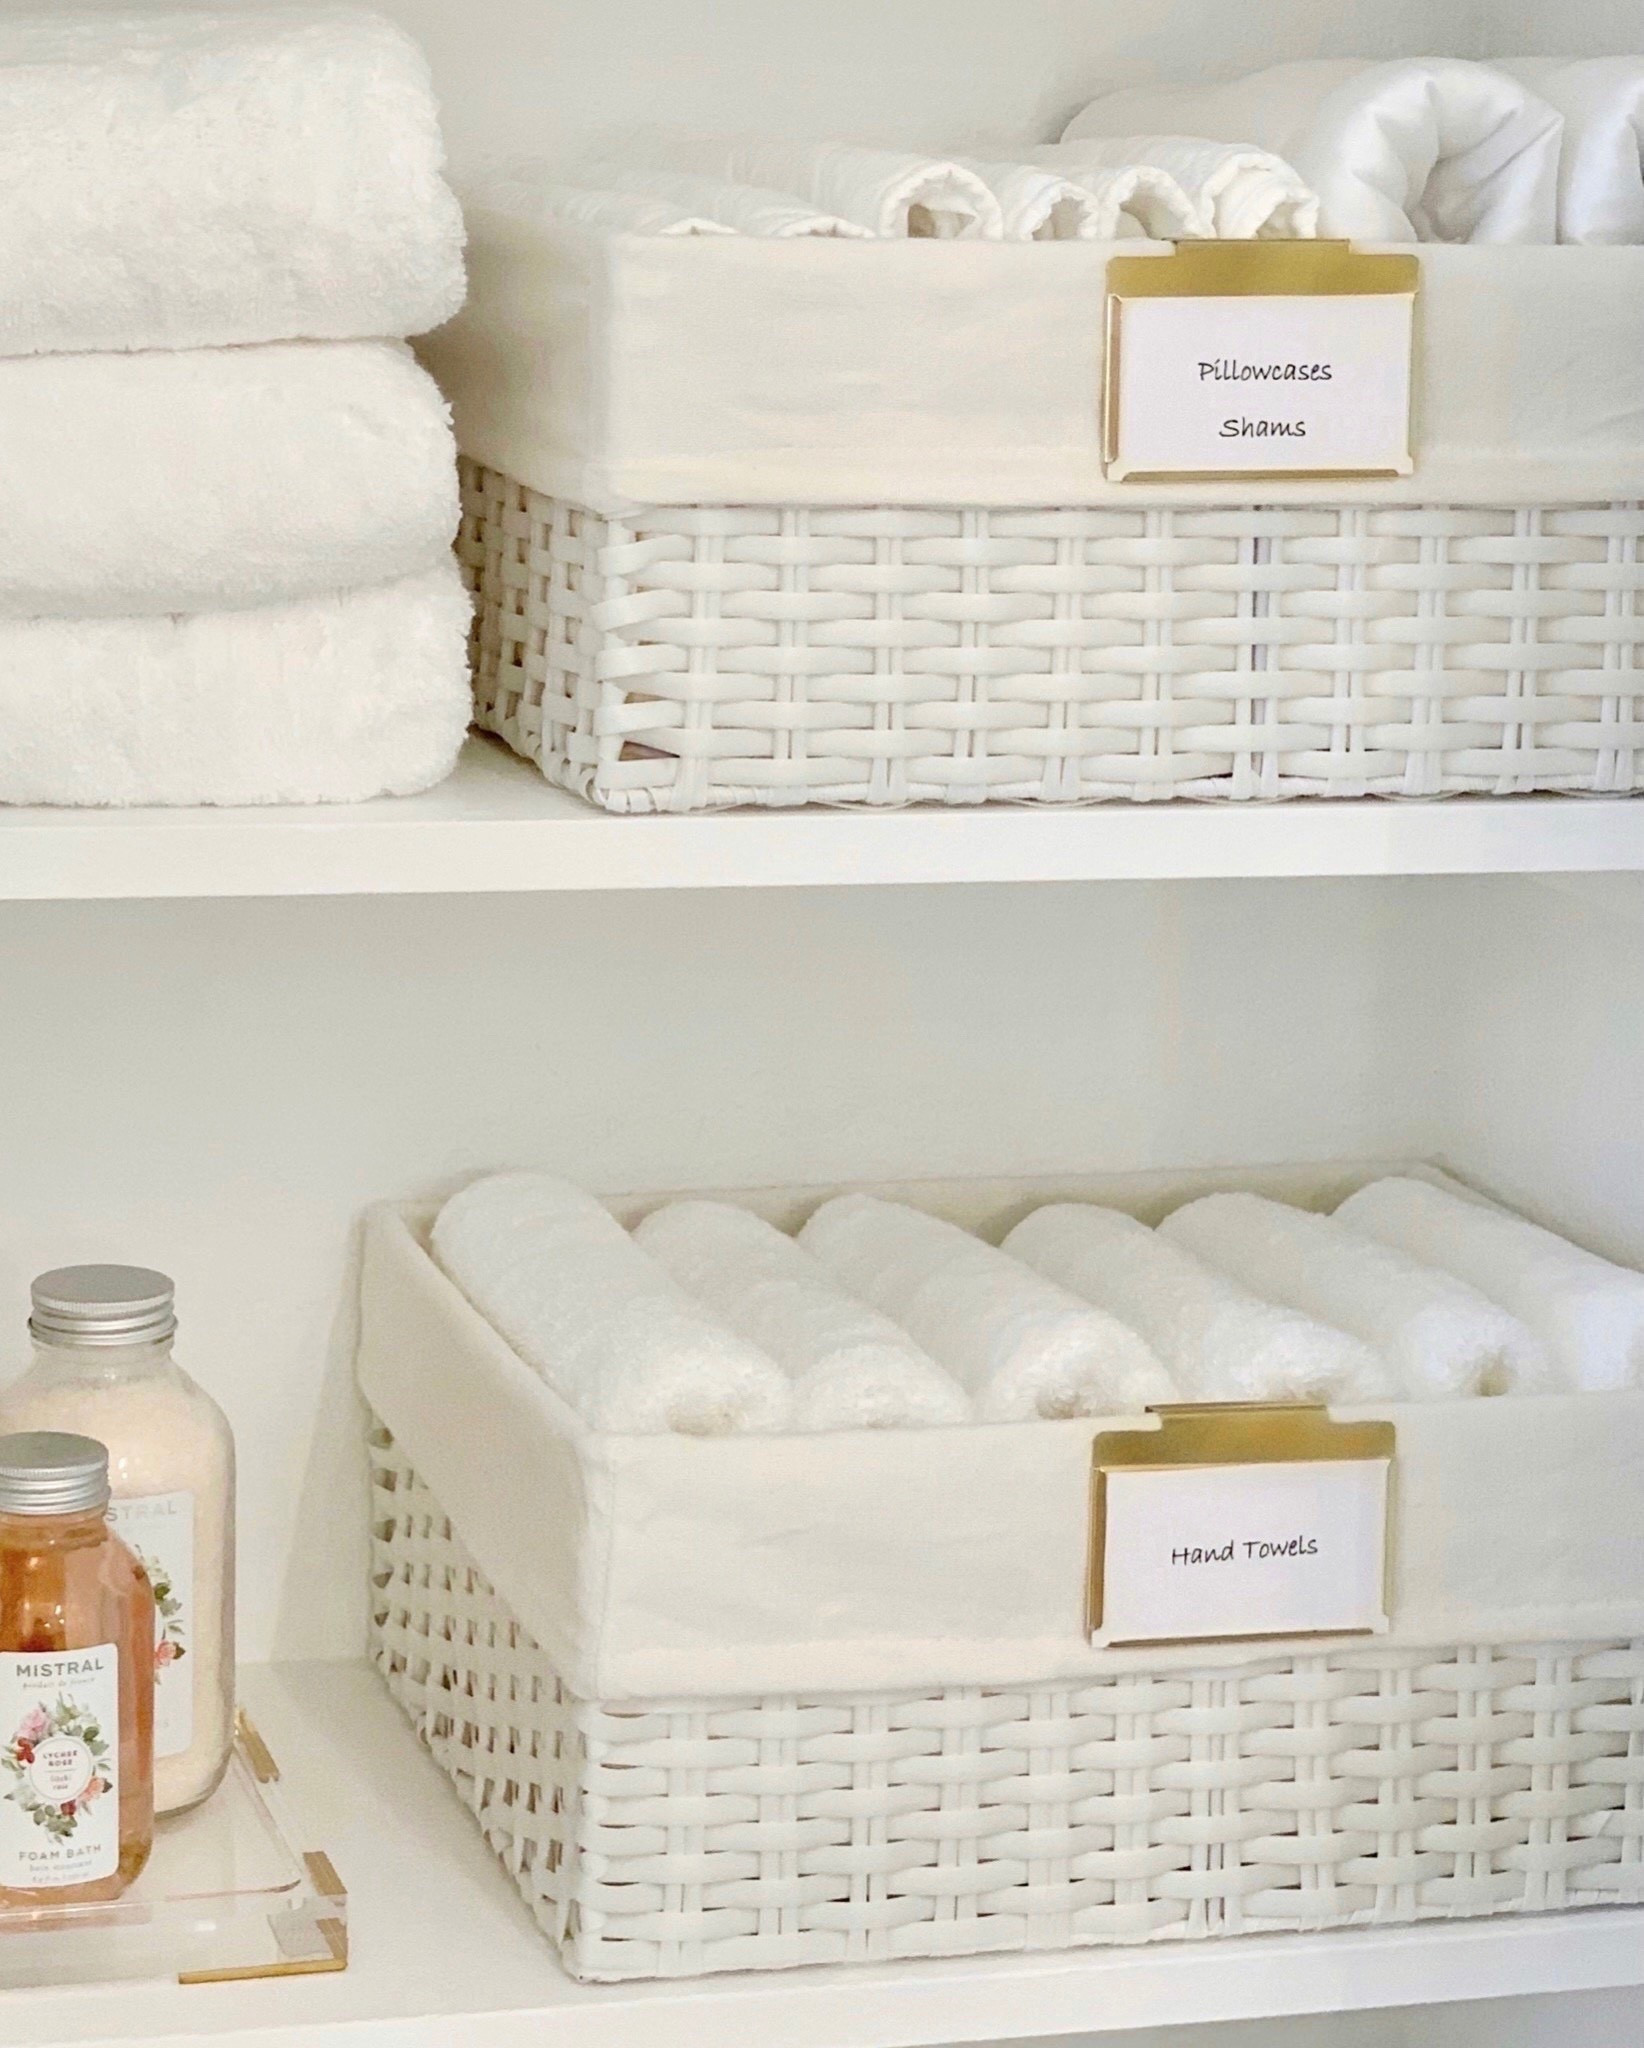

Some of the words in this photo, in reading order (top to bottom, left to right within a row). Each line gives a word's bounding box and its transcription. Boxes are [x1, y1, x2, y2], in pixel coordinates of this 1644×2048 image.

[1198, 358, 1333, 381] Pillowcases
[1218, 416, 1306, 438] Shams
[1171, 1539, 1235, 1566] Hand
[1242, 1534, 1319, 1559] Towels
[16, 1658, 104, 1677] MISTRAL
[18, 1851, 60, 1861] FOAM
[66, 1844, 101, 1859] BATH
